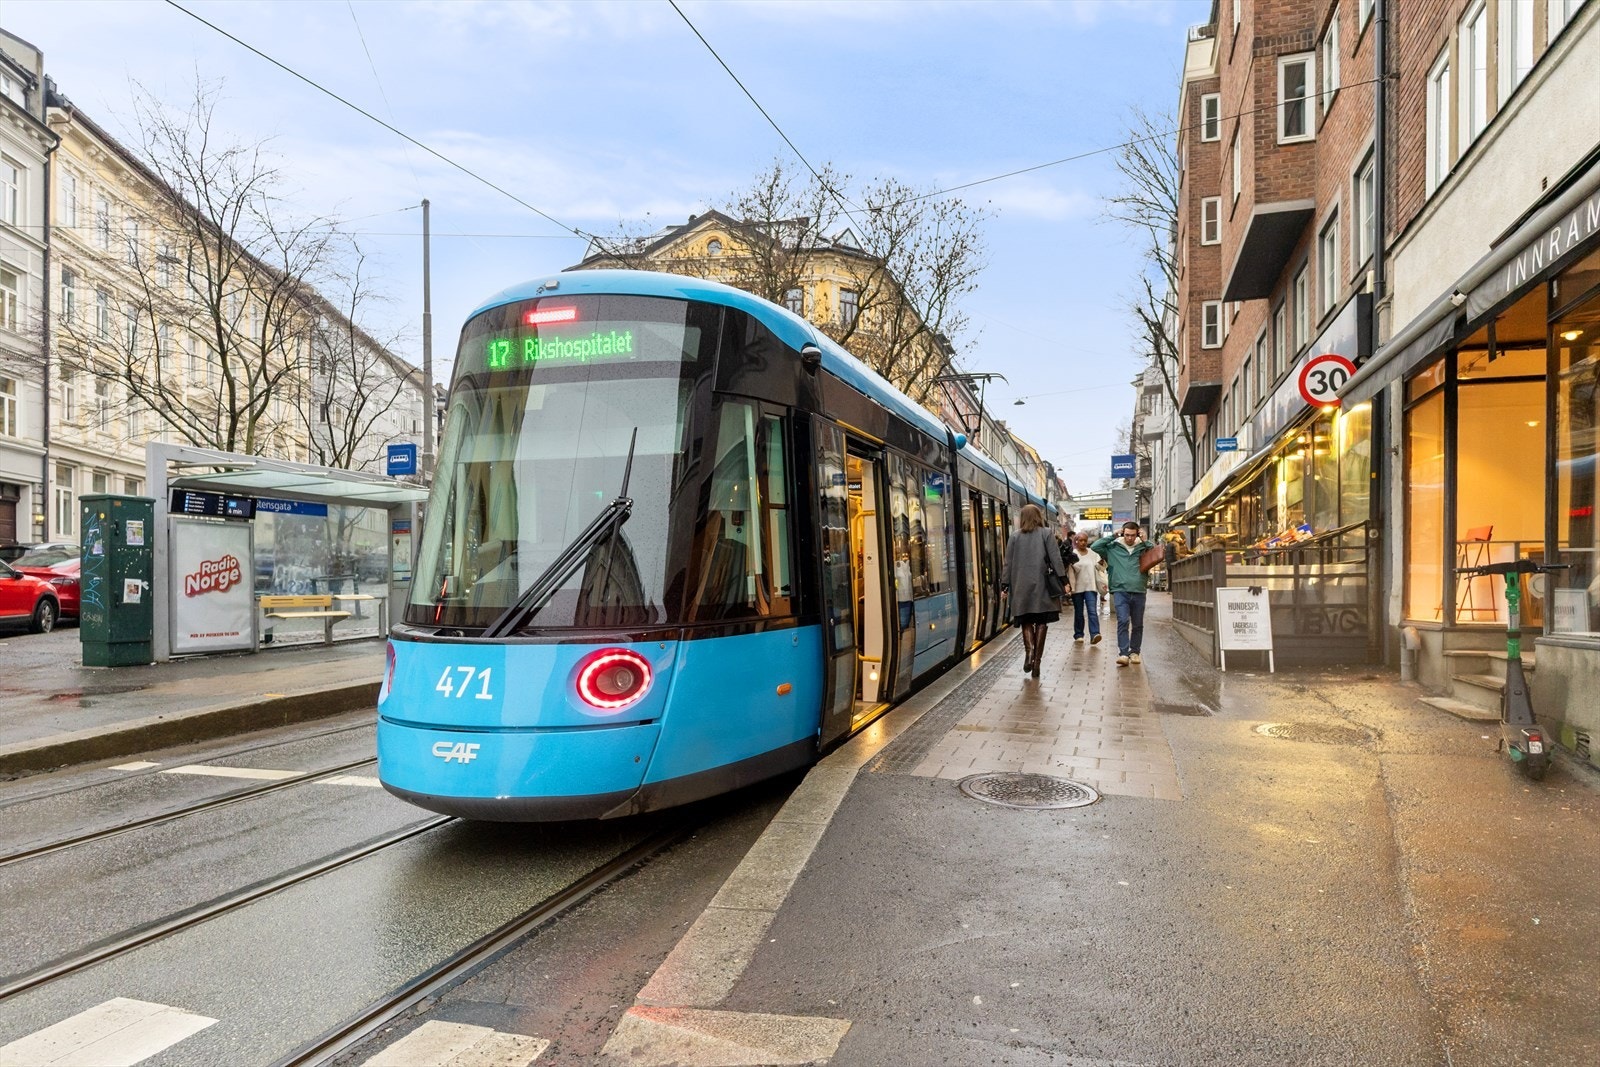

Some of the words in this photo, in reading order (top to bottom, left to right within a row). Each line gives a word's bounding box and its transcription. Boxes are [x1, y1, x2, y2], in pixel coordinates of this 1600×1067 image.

[1506, 198, 1600, 292] INNRAM
[490, 341, 510, 367] 17
[524, 331, 633, 361] Rikshospitalet
[1309, 367, 1348, 395] 30
[201, 556, 237, 575] Radio
[186, 568, 239, 594] Norge
[1227, 602, 1259, 611] HUNDESPA
[1232, 621, 1258, 629] LAGERSALG
[435, 665, 493, 700] 471
[431, 741, 481, 764] CAF
